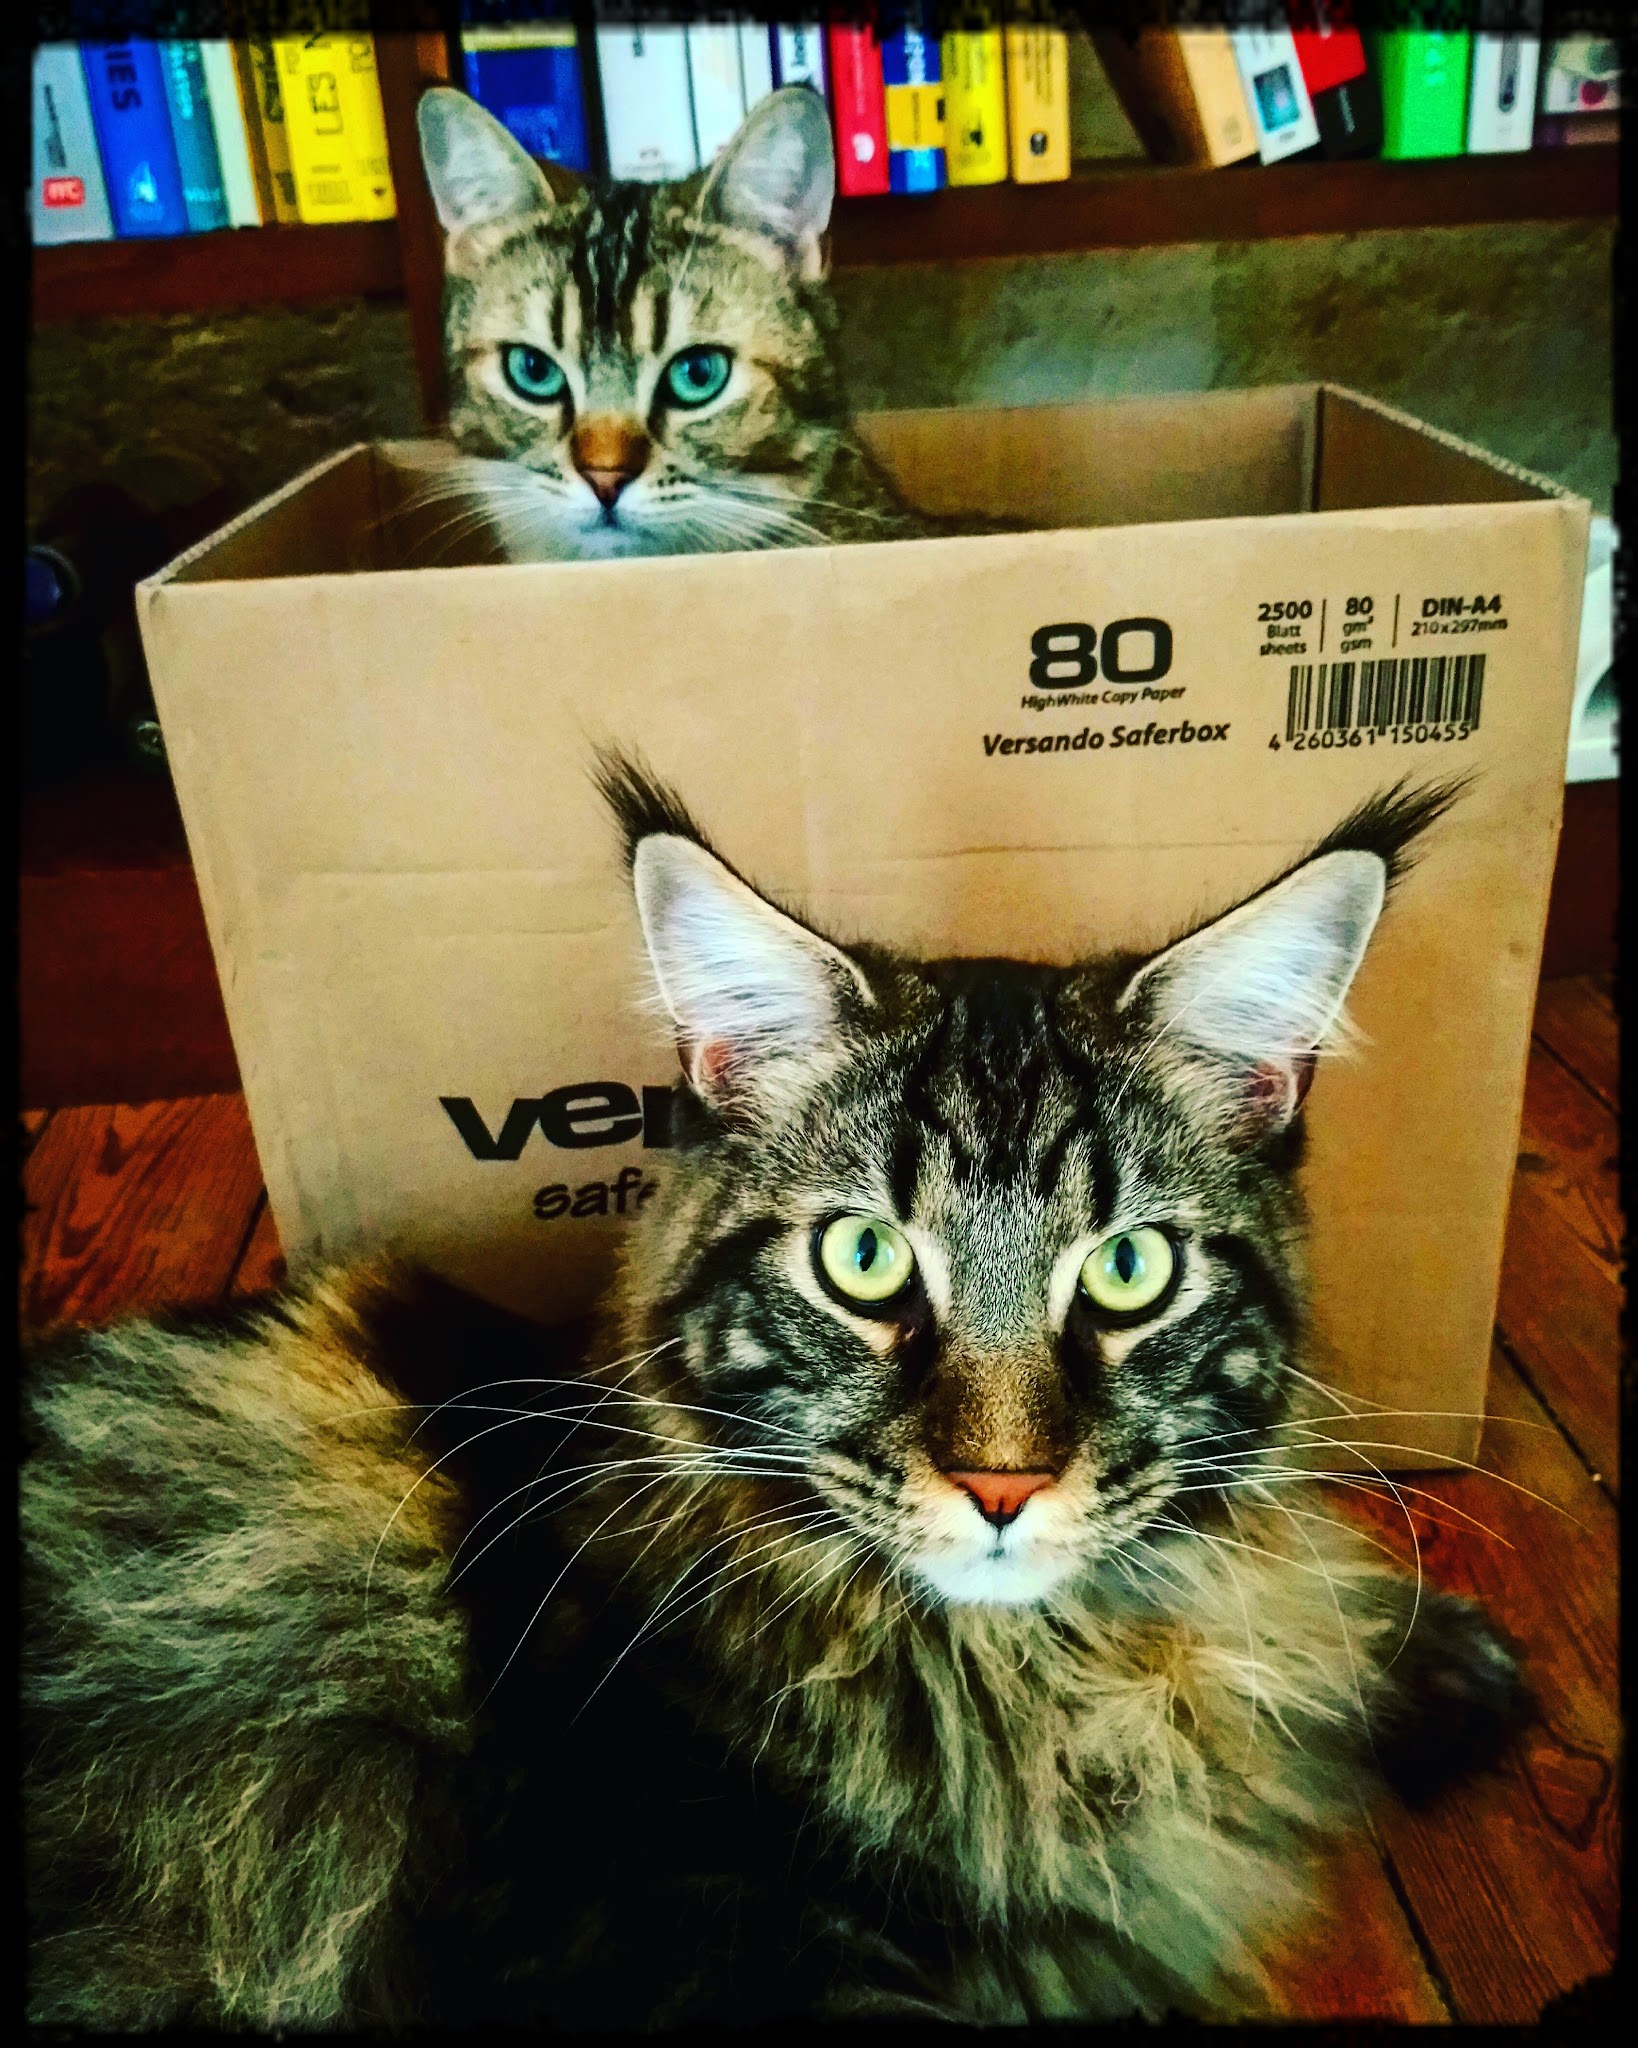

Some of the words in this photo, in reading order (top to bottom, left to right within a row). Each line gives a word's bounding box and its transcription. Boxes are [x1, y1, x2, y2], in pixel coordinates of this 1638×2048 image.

[1258, 599, 1312, 621] 2500
[1345, 596, 1373, 616] 80
[1421, 594, 1502, 618] DIN-A4
[1267, 624, 1301, 638] Blatt
[1029, 616, 1173, 690] 80
[1260, 642, 1306, 656] sheets
[1340, 638, 1372, 654] gsm
[1101, 689, 1139, 706] Copy
[1141, 686, 1186, 703] Paper
[982, 727, 1104, 757] Versando
[1109, 719, 1232, 748] Saferbox
[1268, 733, 1281, 751] 4
[1293, 727, 1377, 751] 260361
[1390, 722, 1471, 745] 150455
